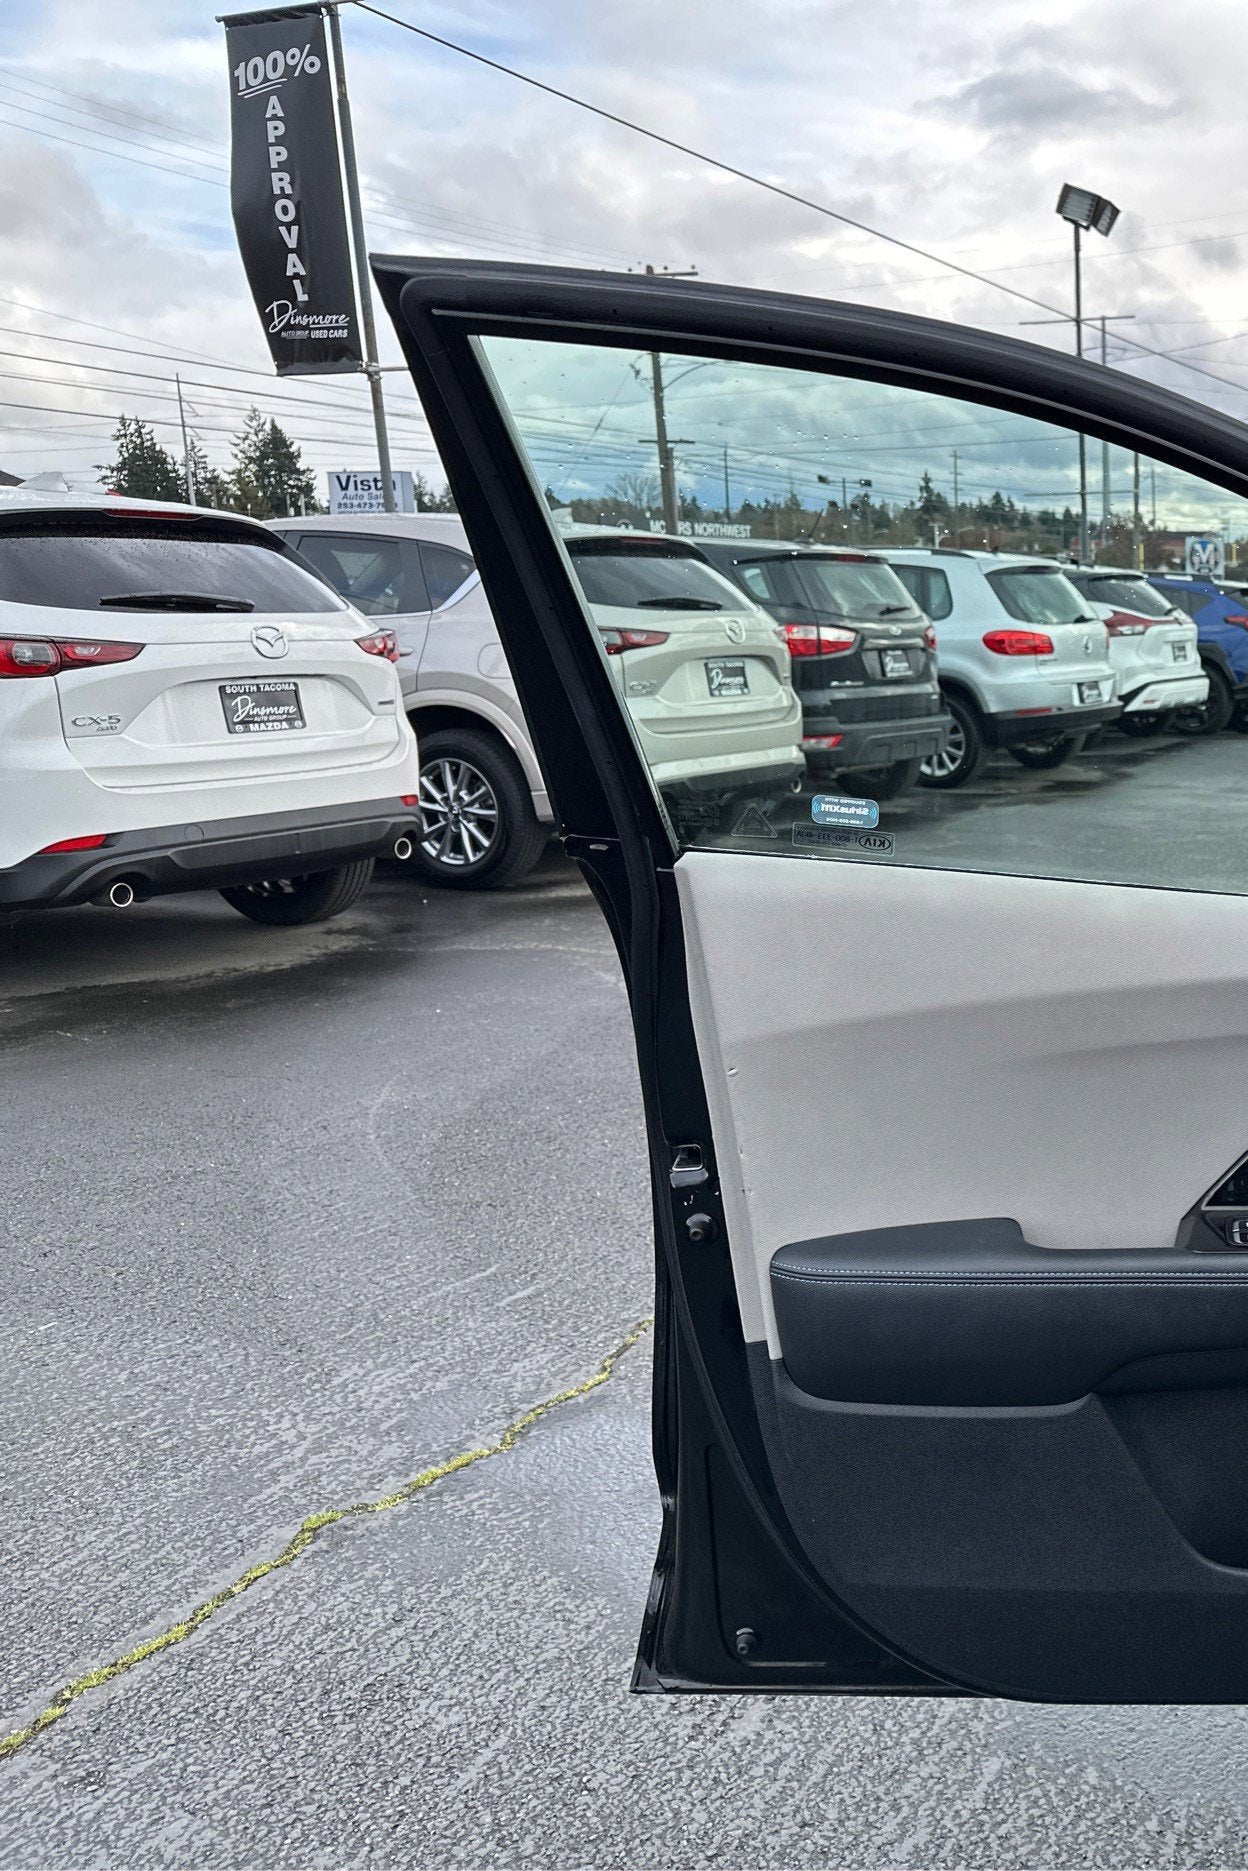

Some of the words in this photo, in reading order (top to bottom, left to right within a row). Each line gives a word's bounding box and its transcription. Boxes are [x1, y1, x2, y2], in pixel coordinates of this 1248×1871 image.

[233, 43, 322, 91] 100%
[264, 95, 310, 302] APPROVAL
[265, 299, 350, 333] Dinsmore
[311, 329, 328, 339] USED
[329, 329, 348, 338] CARS
[335, 474, 396, 491] Vist
[342, 492, 365, 501] Auto
[649, 520, 692, 536] MORS
[694, 522, 752, 538] NORTHWEST
[225, 685, 258, 694] SOUTH
[259, 682, 296, 692] TACOMA
[231, 695, 298, 723] Dinsmore
[71, 715, 121, 727] CX-5
[249, 721, 289, 732] MAZDA
